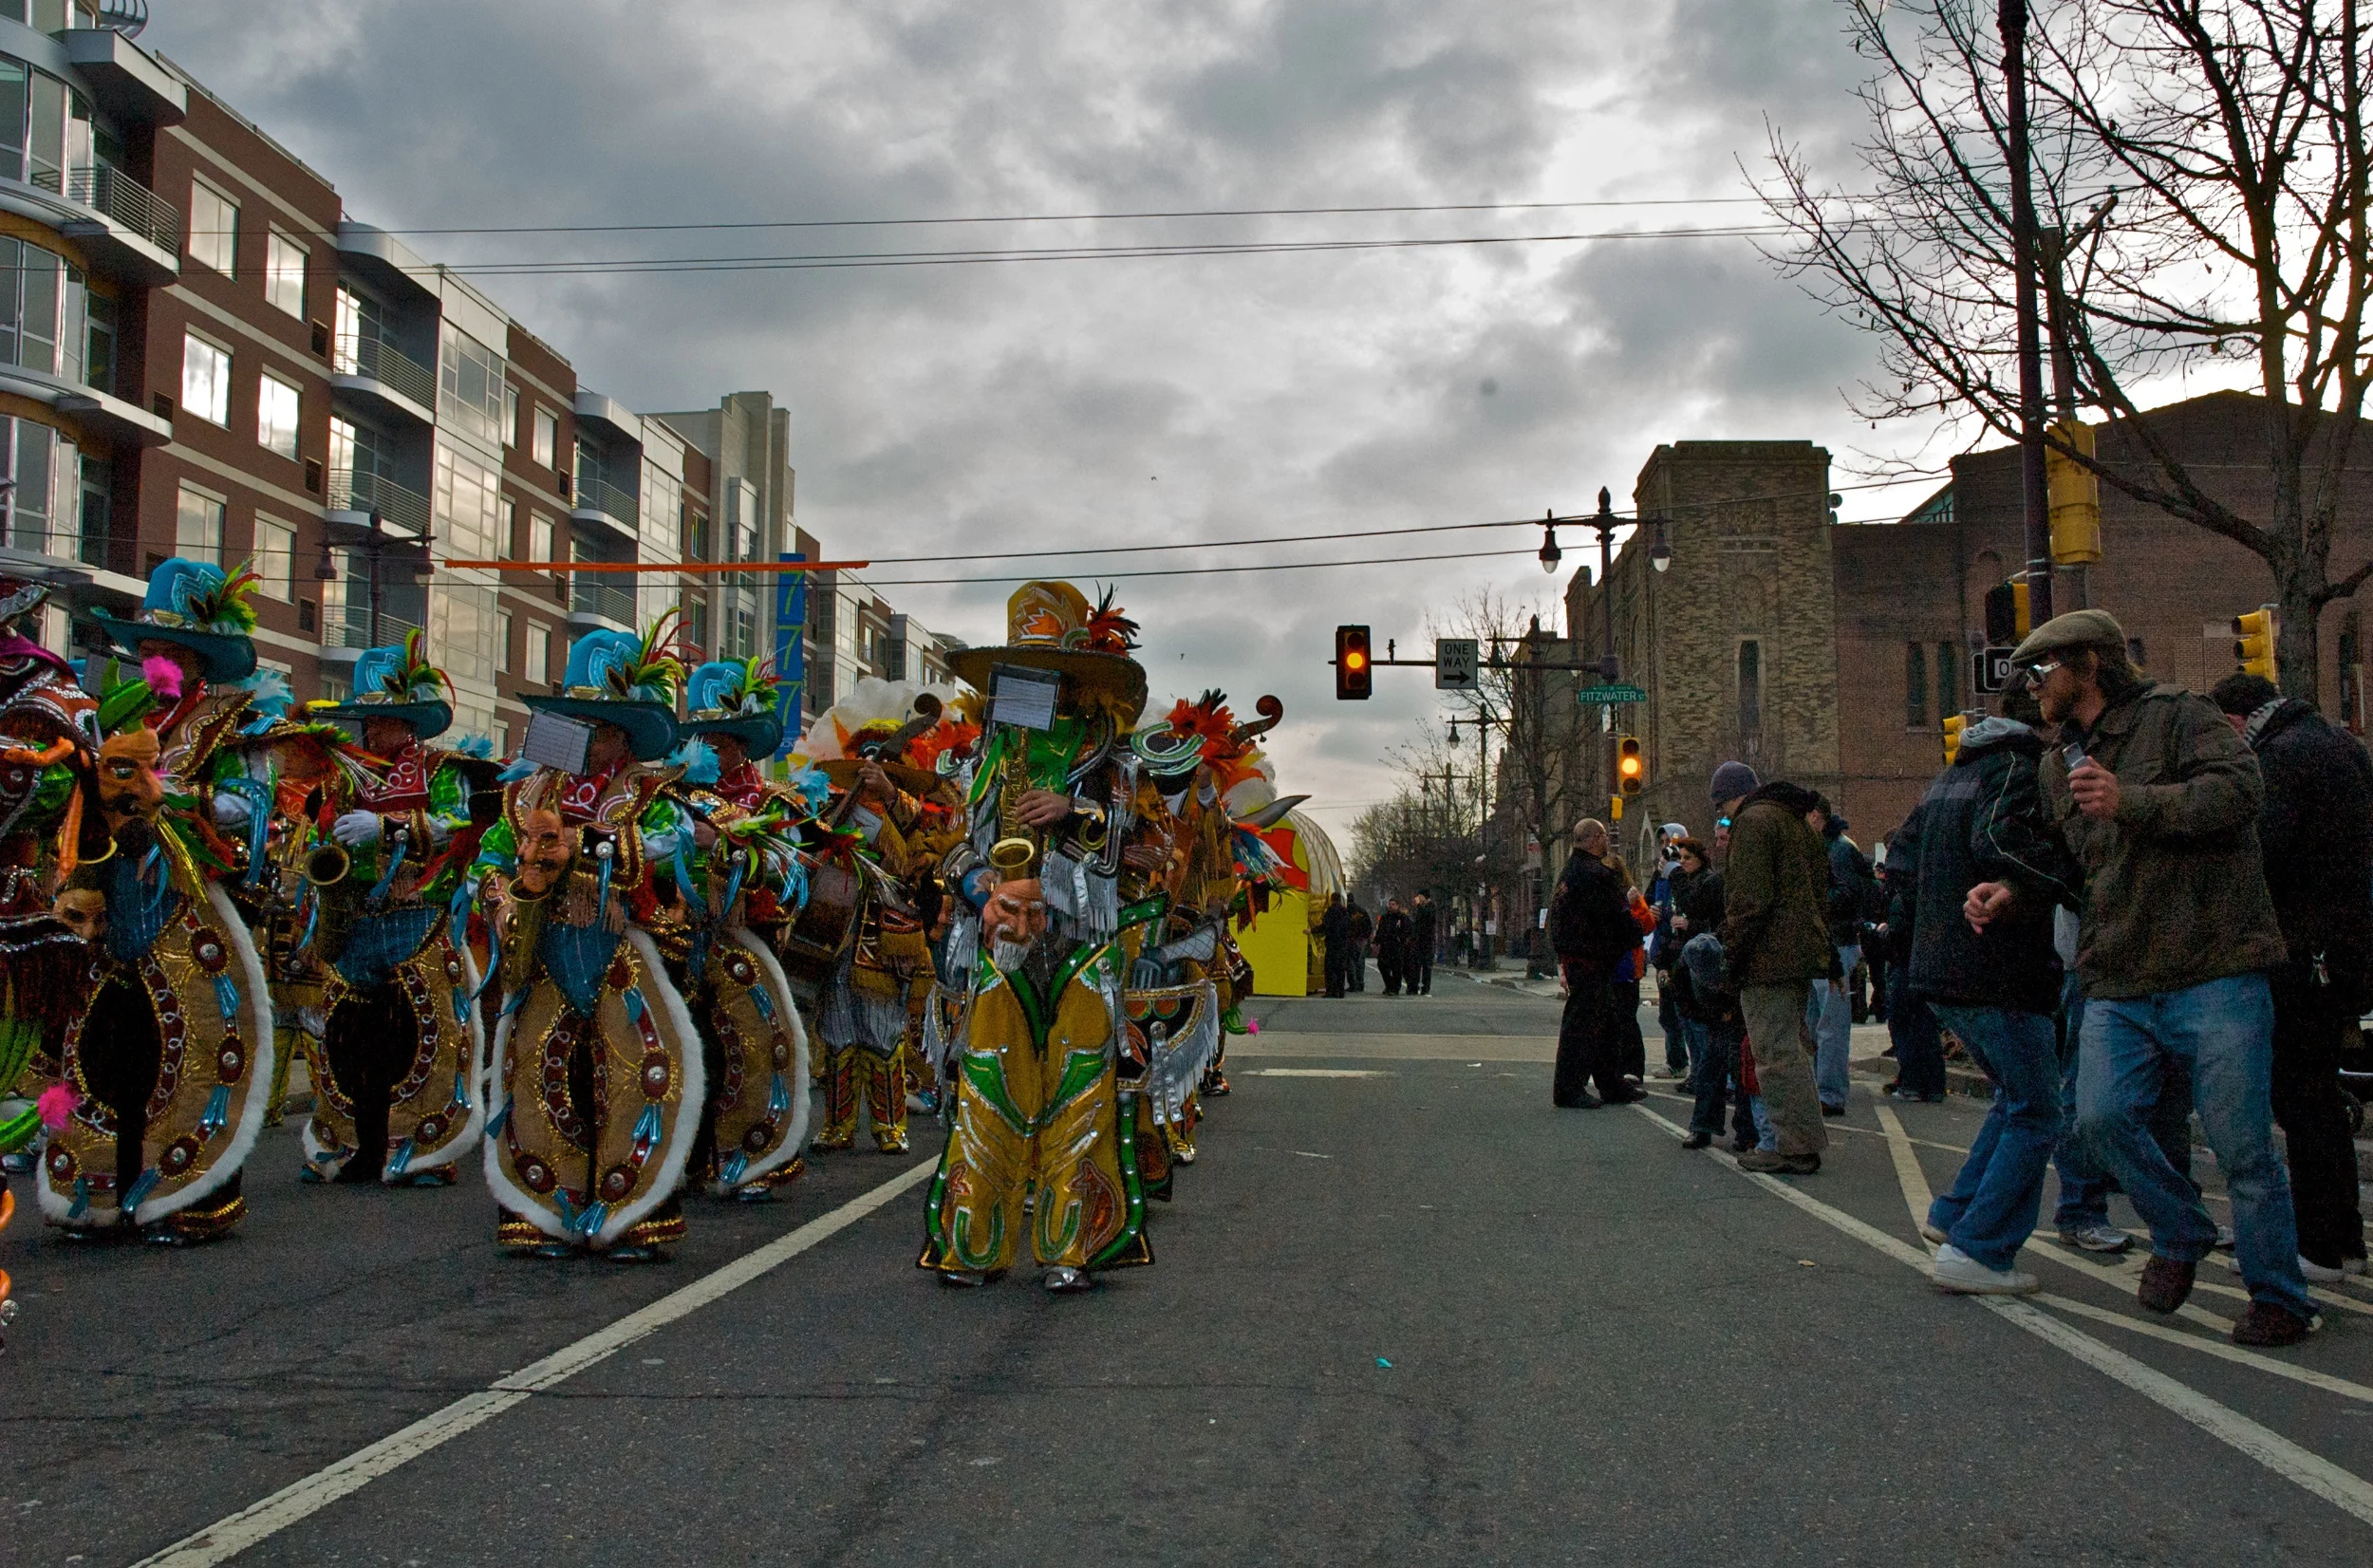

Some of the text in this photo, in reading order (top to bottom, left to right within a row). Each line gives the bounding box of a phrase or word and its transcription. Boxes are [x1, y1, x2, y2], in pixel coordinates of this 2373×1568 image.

[1445, 644, 1469, 655] ONE
[1444, 657, 1470, 668] WAY
[1580, 691, 1636, 701] FITZWATER
